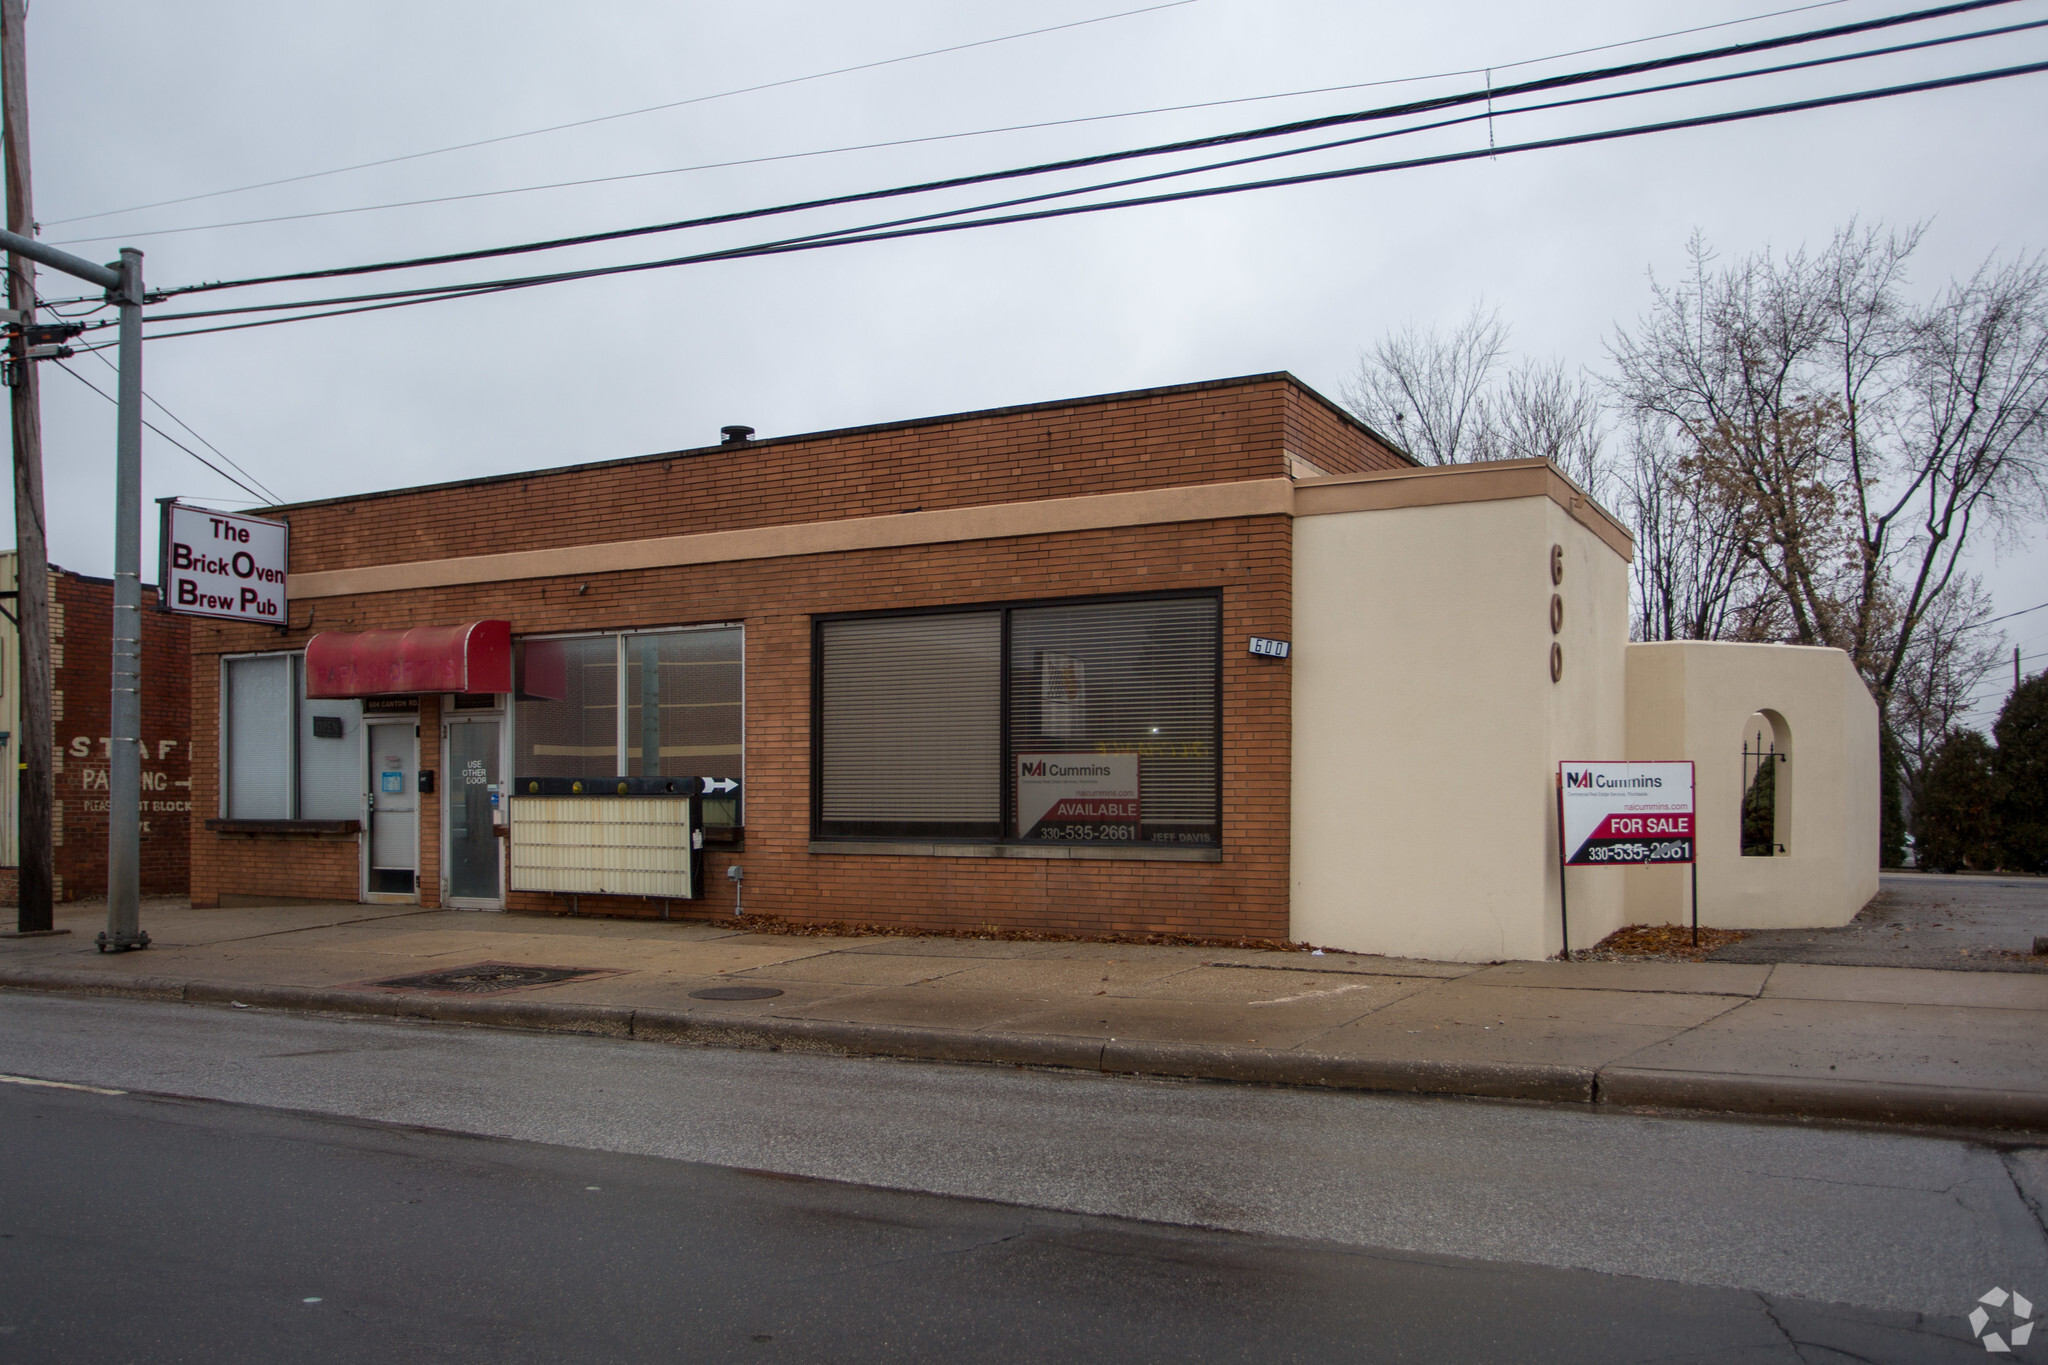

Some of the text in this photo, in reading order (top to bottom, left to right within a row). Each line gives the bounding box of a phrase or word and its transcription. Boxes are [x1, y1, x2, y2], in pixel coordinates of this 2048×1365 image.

[209, 517, 250, 543] The
[172, 542, 284, 584] Brick Oven
[178, 578, 278, 616] Brew Pub
[1255, 639, 1282, 655] 600
[467, 760, 482, 768] USE
[1022, 759, 1111, 777] NAI Cummins
[83, 769, 167, 790] PANG
[1567, 769, 1662, 788] NAI Cummins
[1076, 789, 1134, 798] naicummins.com
[1057, 803, 1137, 816] AVAILABLE
[1624, 803, 1688, 811] naicummins.com
[1041, 825, 1136, 840] 330-535-2661
[1611, 818, 1689, 833] FOR SALE
[1151, 832, 1211, 843] JEFF DAVIS
